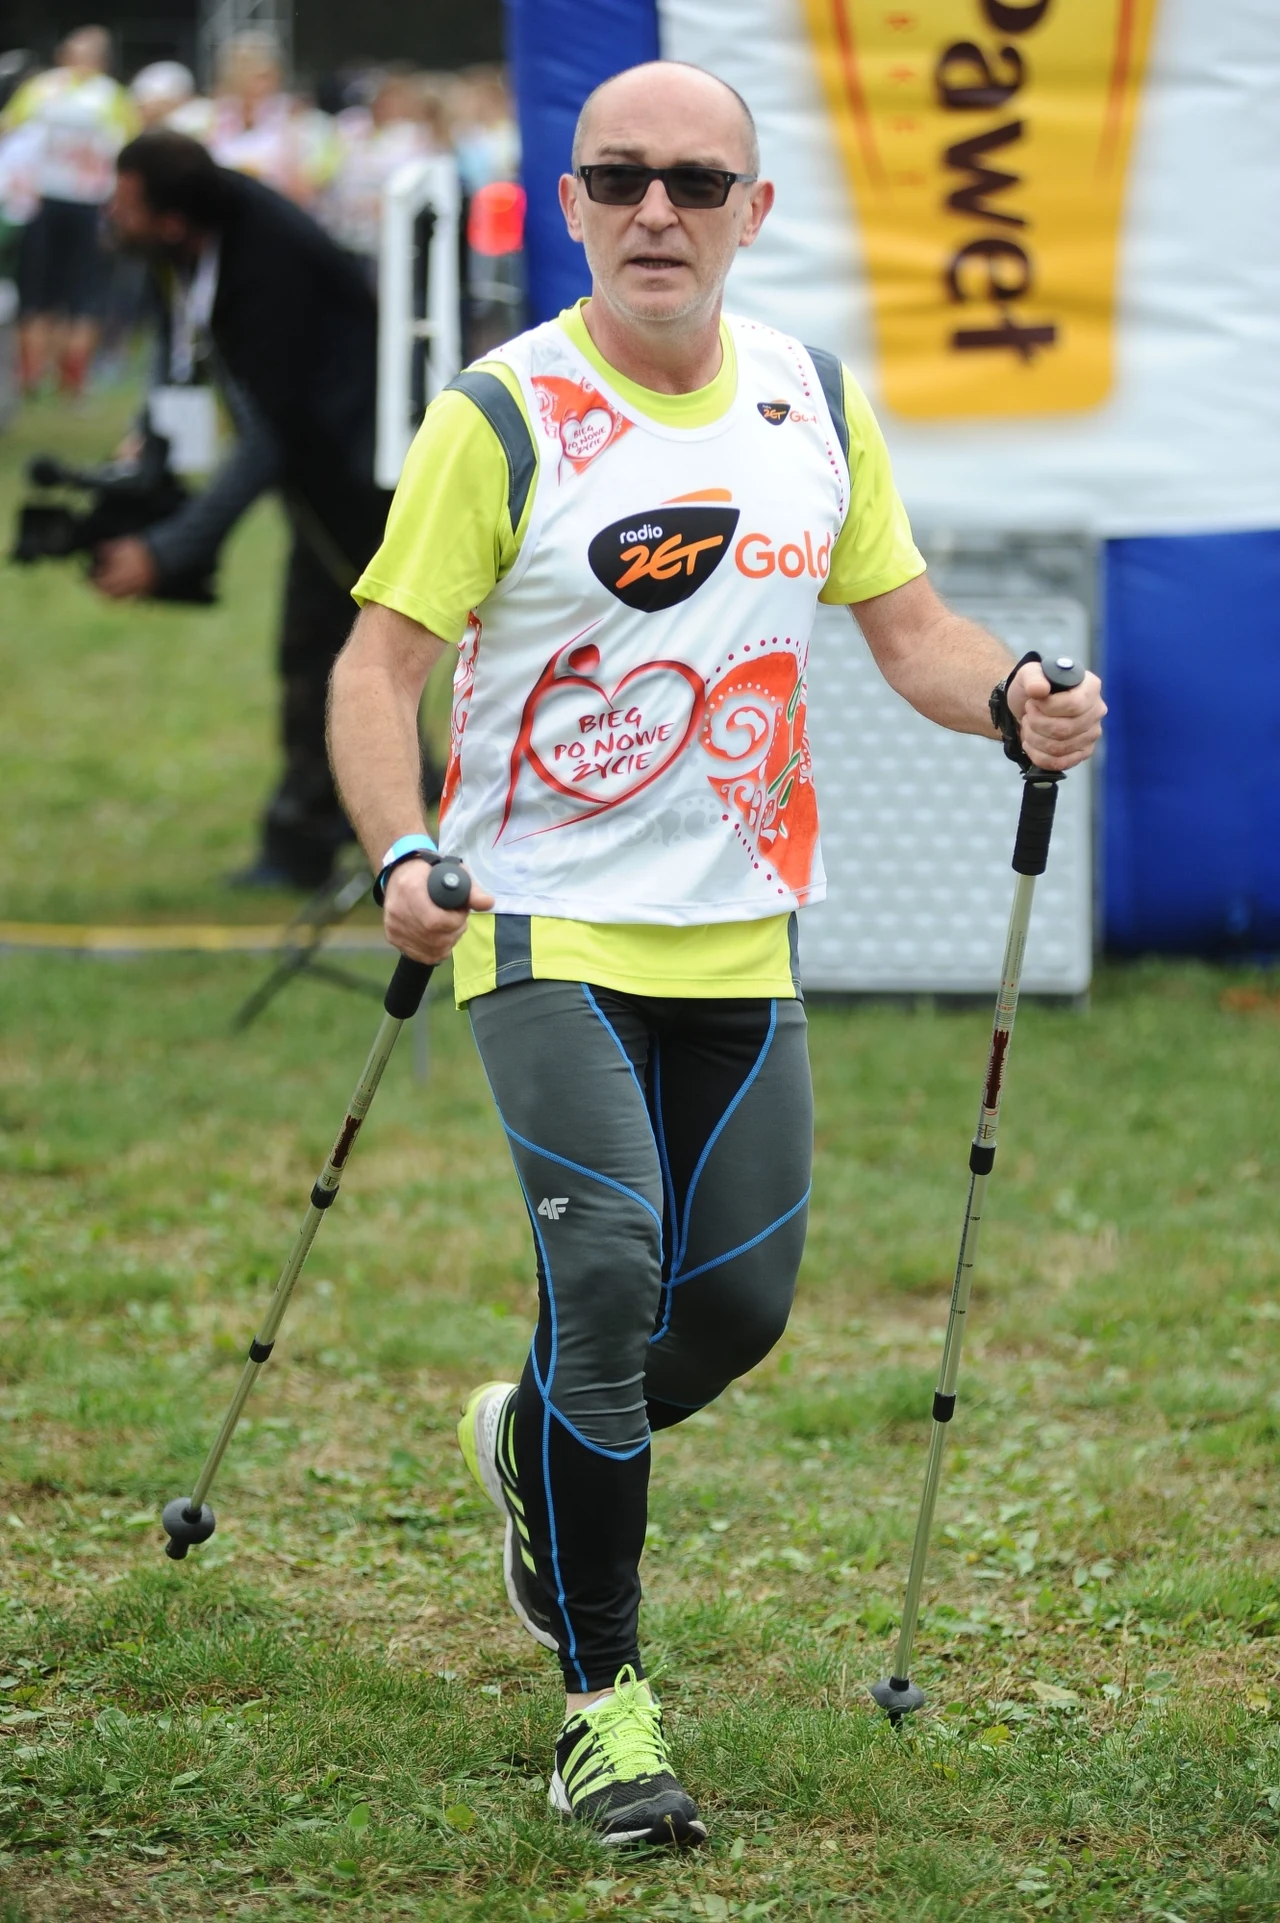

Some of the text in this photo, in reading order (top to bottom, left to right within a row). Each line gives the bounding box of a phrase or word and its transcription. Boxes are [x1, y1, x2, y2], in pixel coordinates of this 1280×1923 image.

[573, 424, 594, 438] BIEG
[580, 427, 606, 445] NOWE
[620, 524, 664, 544] radio
[734, 530, 831, 580] Gold
[578, 706, 642, 734] BIEG
[554, 722, 675, 761] PO NOWE
[571, 751, 653, 782] ŻYCIE
[537, 1197, 570, 1220] 4F
